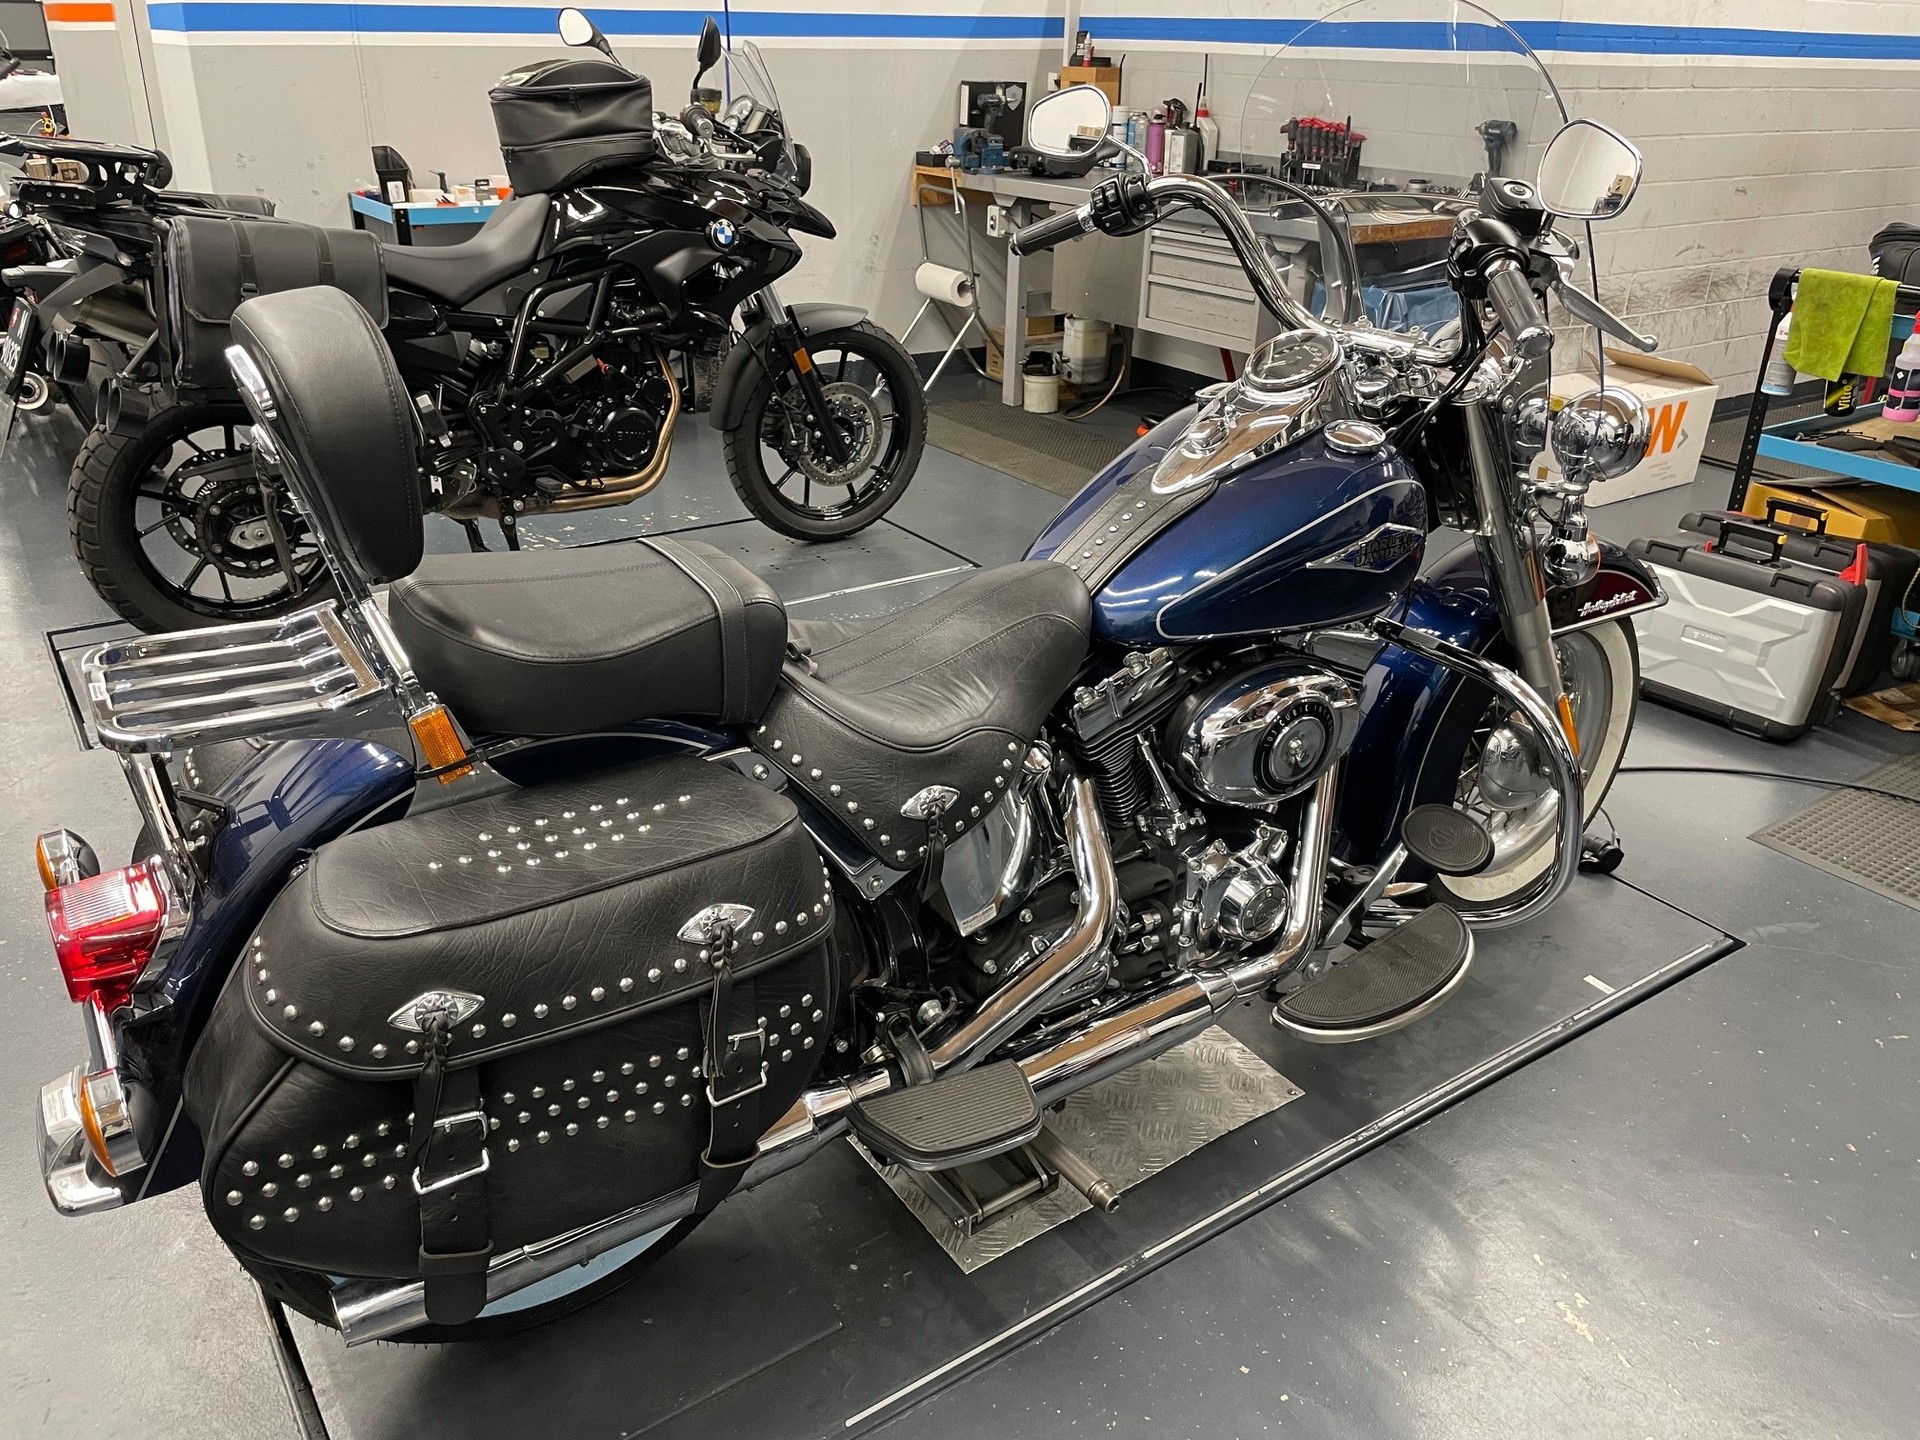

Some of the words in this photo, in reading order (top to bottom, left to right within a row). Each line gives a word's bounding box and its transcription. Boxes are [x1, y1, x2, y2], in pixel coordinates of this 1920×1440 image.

[1354, 541, 1413, 568] DAVIDSON
[1360, 530, 1412, 556] HARLEY
[1279, 704, 1309, 727] CUBIC
